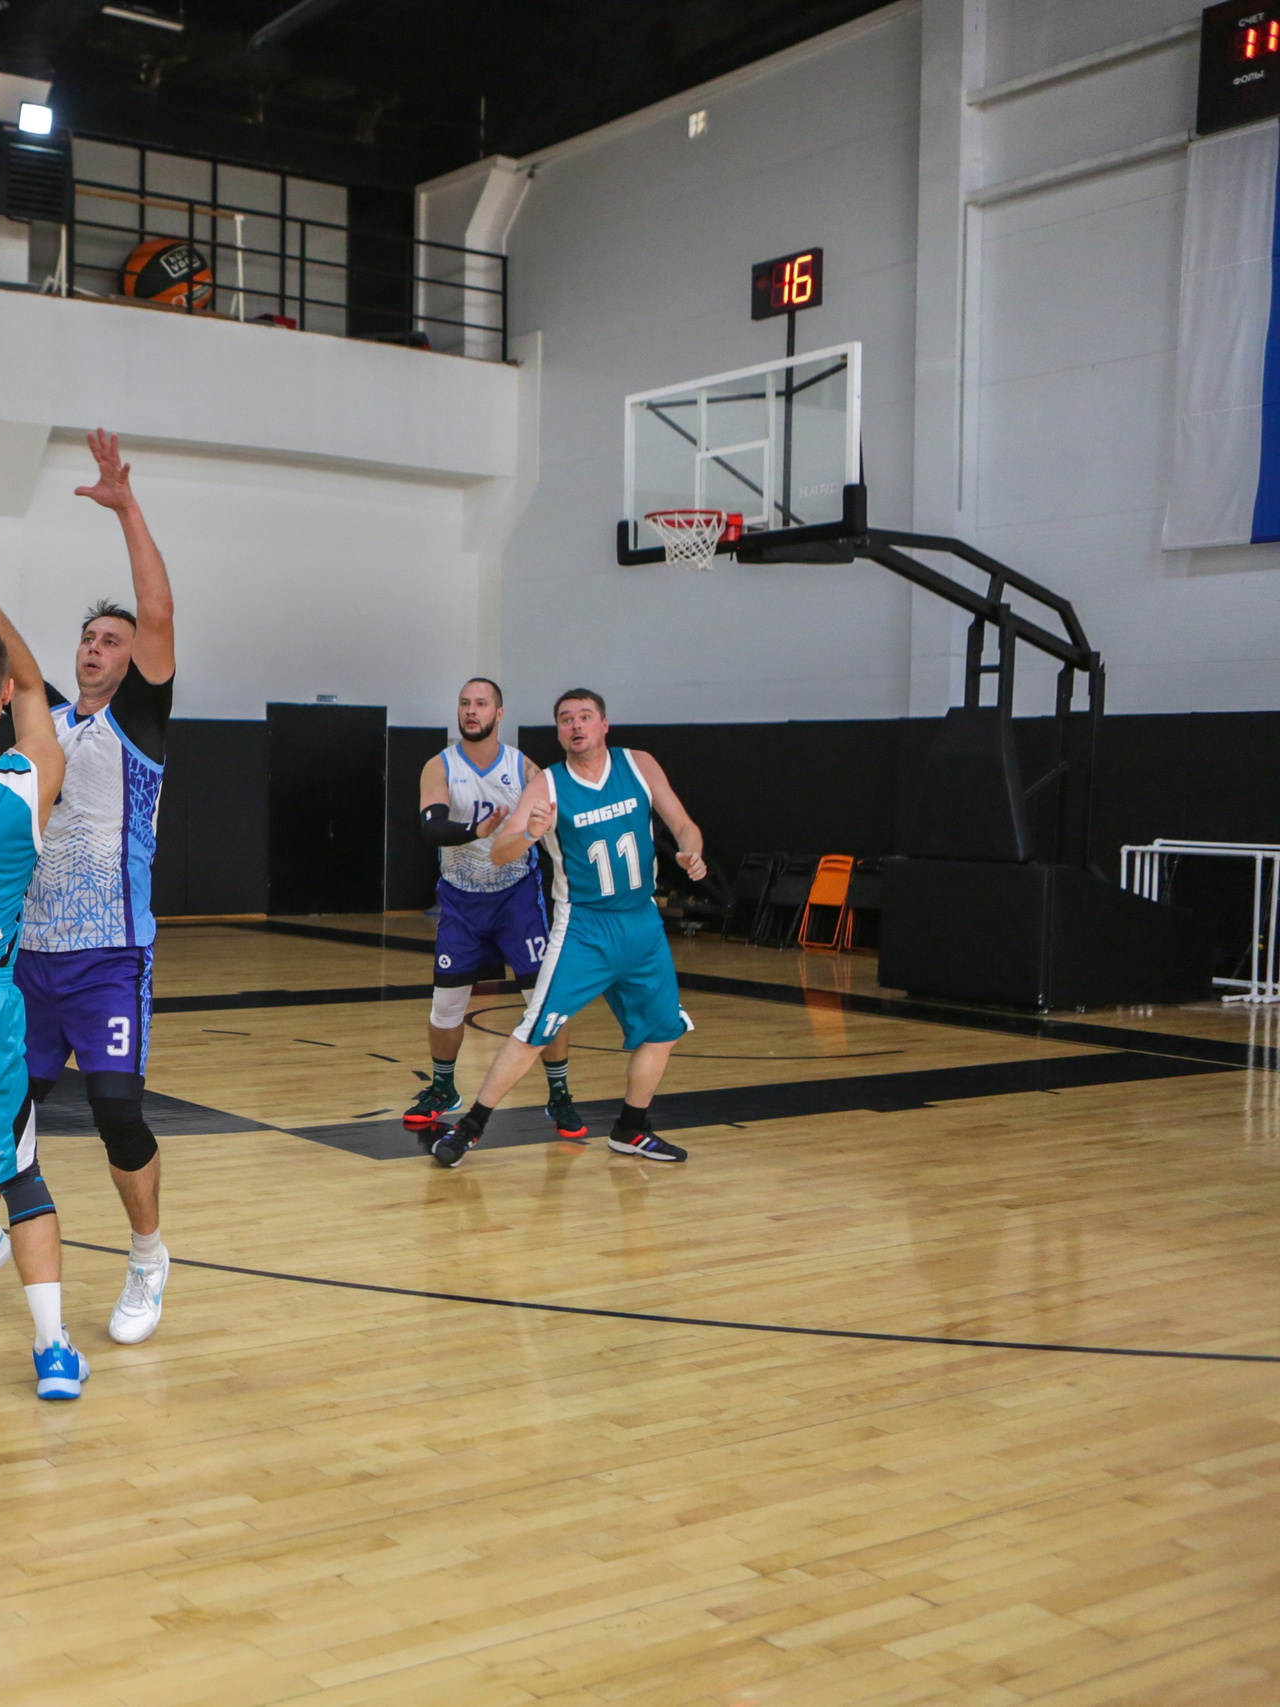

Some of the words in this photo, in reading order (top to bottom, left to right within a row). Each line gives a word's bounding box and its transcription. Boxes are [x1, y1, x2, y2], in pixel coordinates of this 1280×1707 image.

[1246, 20, 1279, 59] 11
[1232, 69, 1265, 85] ФОЛЫ
[782, 254, 813, 304] 16
[573, 798, 638, 828] СИБУР
[587, 831, 642, 896] 11
[525, 936, 547, 963] 12
[106, 1016, 130, 1057] 3
